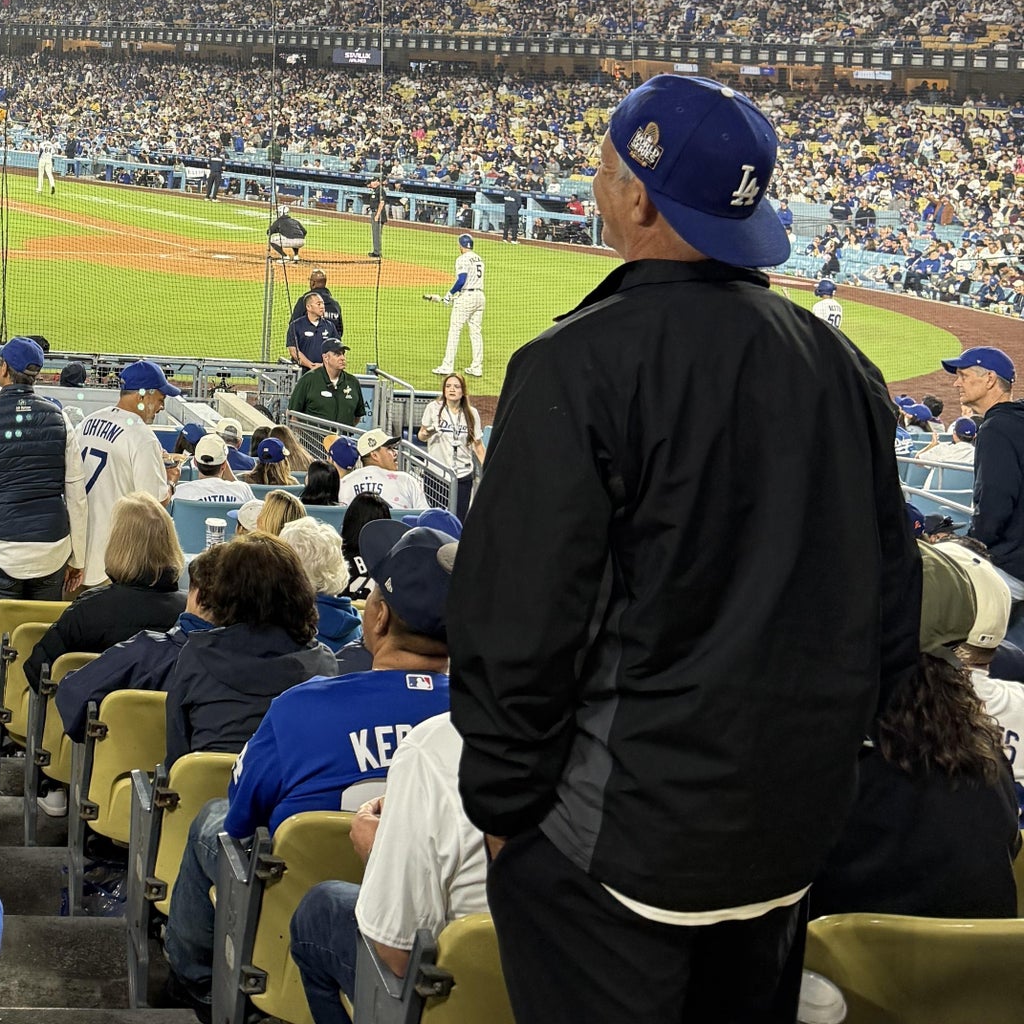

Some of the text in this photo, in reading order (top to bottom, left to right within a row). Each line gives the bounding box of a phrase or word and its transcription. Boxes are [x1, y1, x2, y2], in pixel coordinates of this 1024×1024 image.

[730, 164, 760, 206] LA
[476, 264, 482, 278] 5
[828, 313, 842, 328] 50
[83, 418, 124, 444] OHTANI
[354, 482, 384, 496] BETTS
